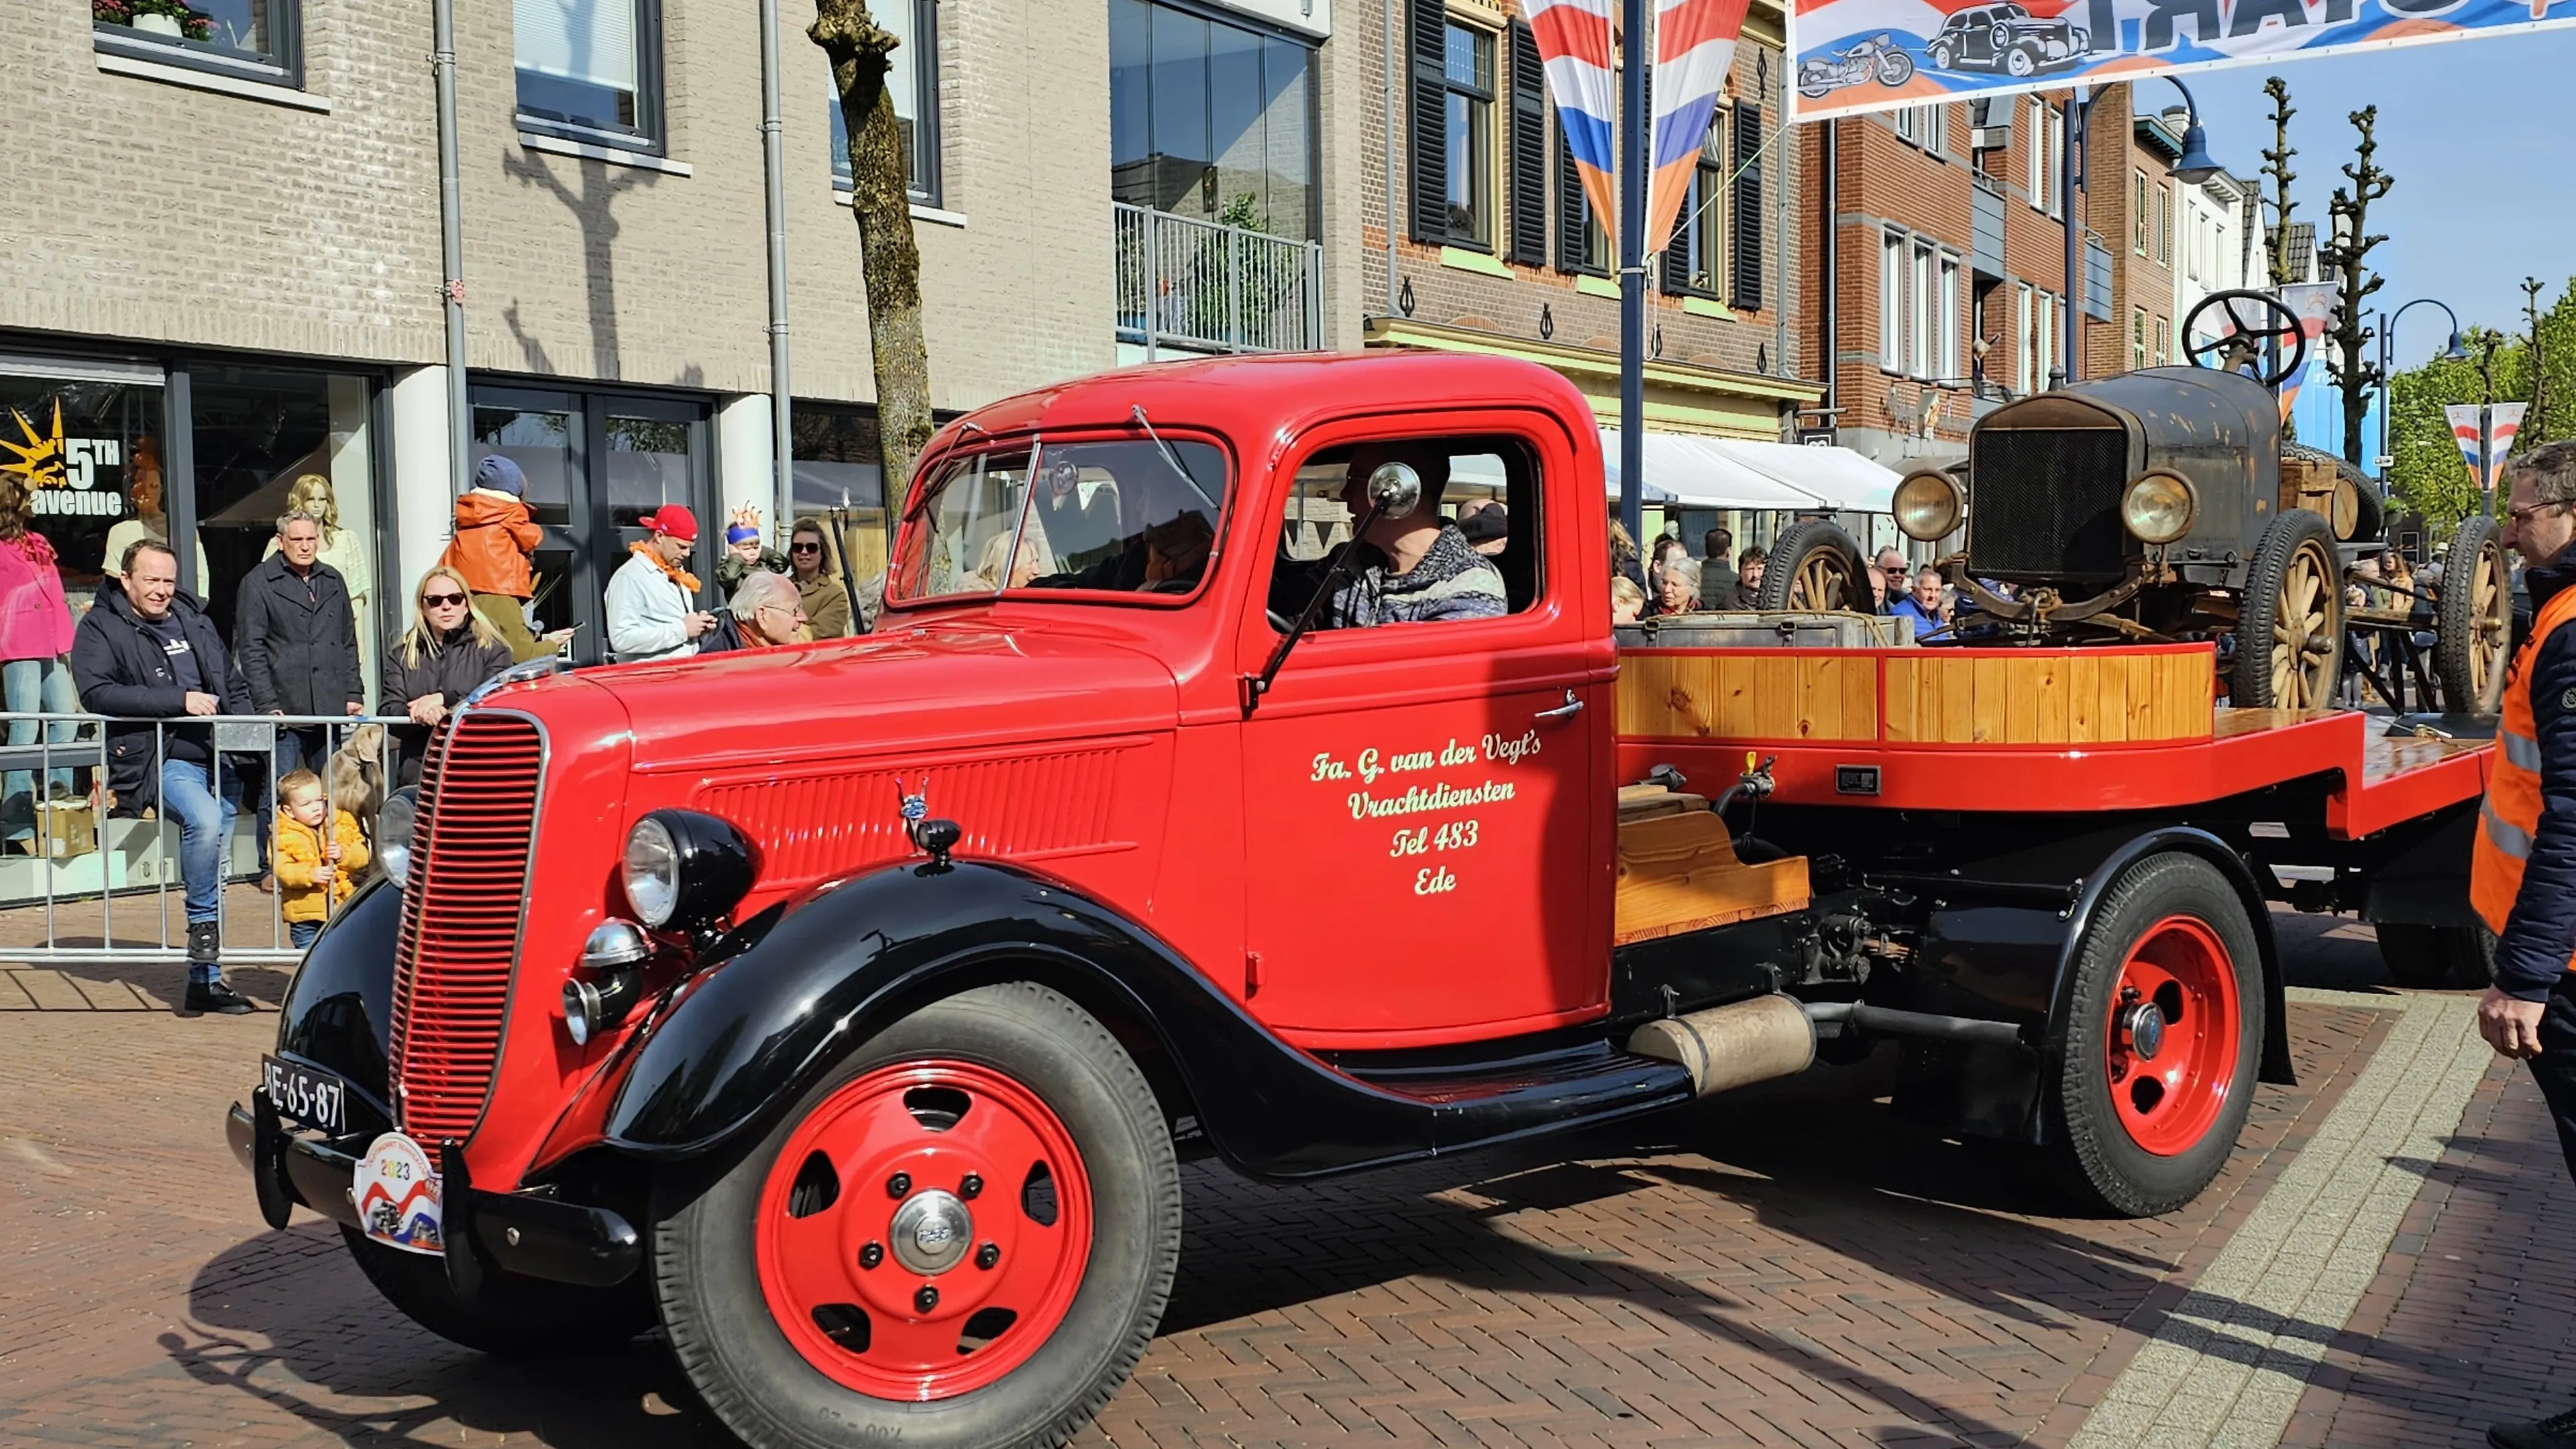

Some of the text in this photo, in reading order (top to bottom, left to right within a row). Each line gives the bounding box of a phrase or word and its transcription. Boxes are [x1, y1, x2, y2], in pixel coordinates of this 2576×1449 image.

[65, 437, 120, 490] 5TH
[30, 489, 122, 516] avenue
[1310, 729, 1542, 784] Fa. G. van der Vegt's
[1347, 780, 1515, 820] Vrachtdiensten
[1389, 819, 1479, 858] Tel 483
[1413, 865, 1457, 896] Ede
[380, 1158, 411, 1181] 2023
